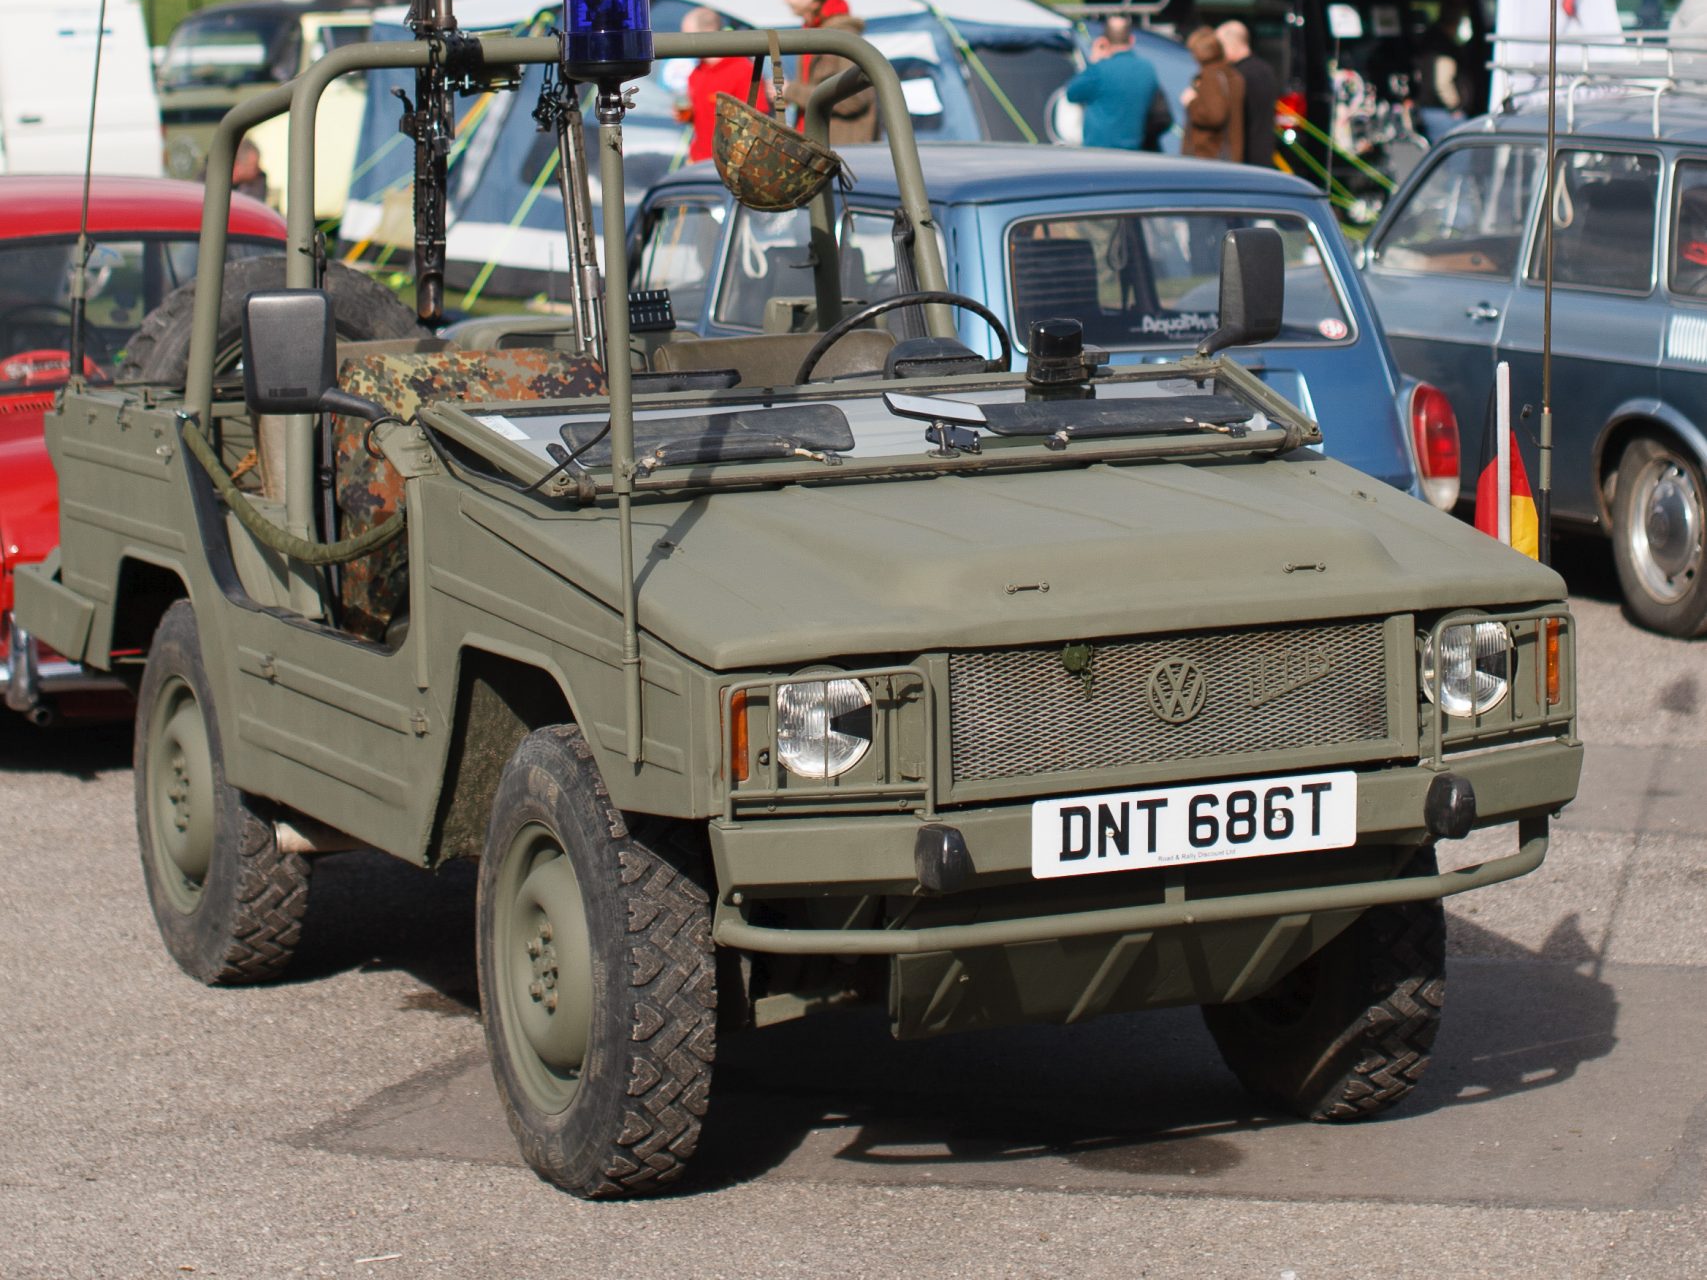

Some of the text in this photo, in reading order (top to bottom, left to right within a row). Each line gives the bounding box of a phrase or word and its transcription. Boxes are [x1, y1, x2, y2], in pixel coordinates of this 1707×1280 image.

[1146, 657, 1206, 723] VW
[1059, 782, 1332, 861] DNT 686T
